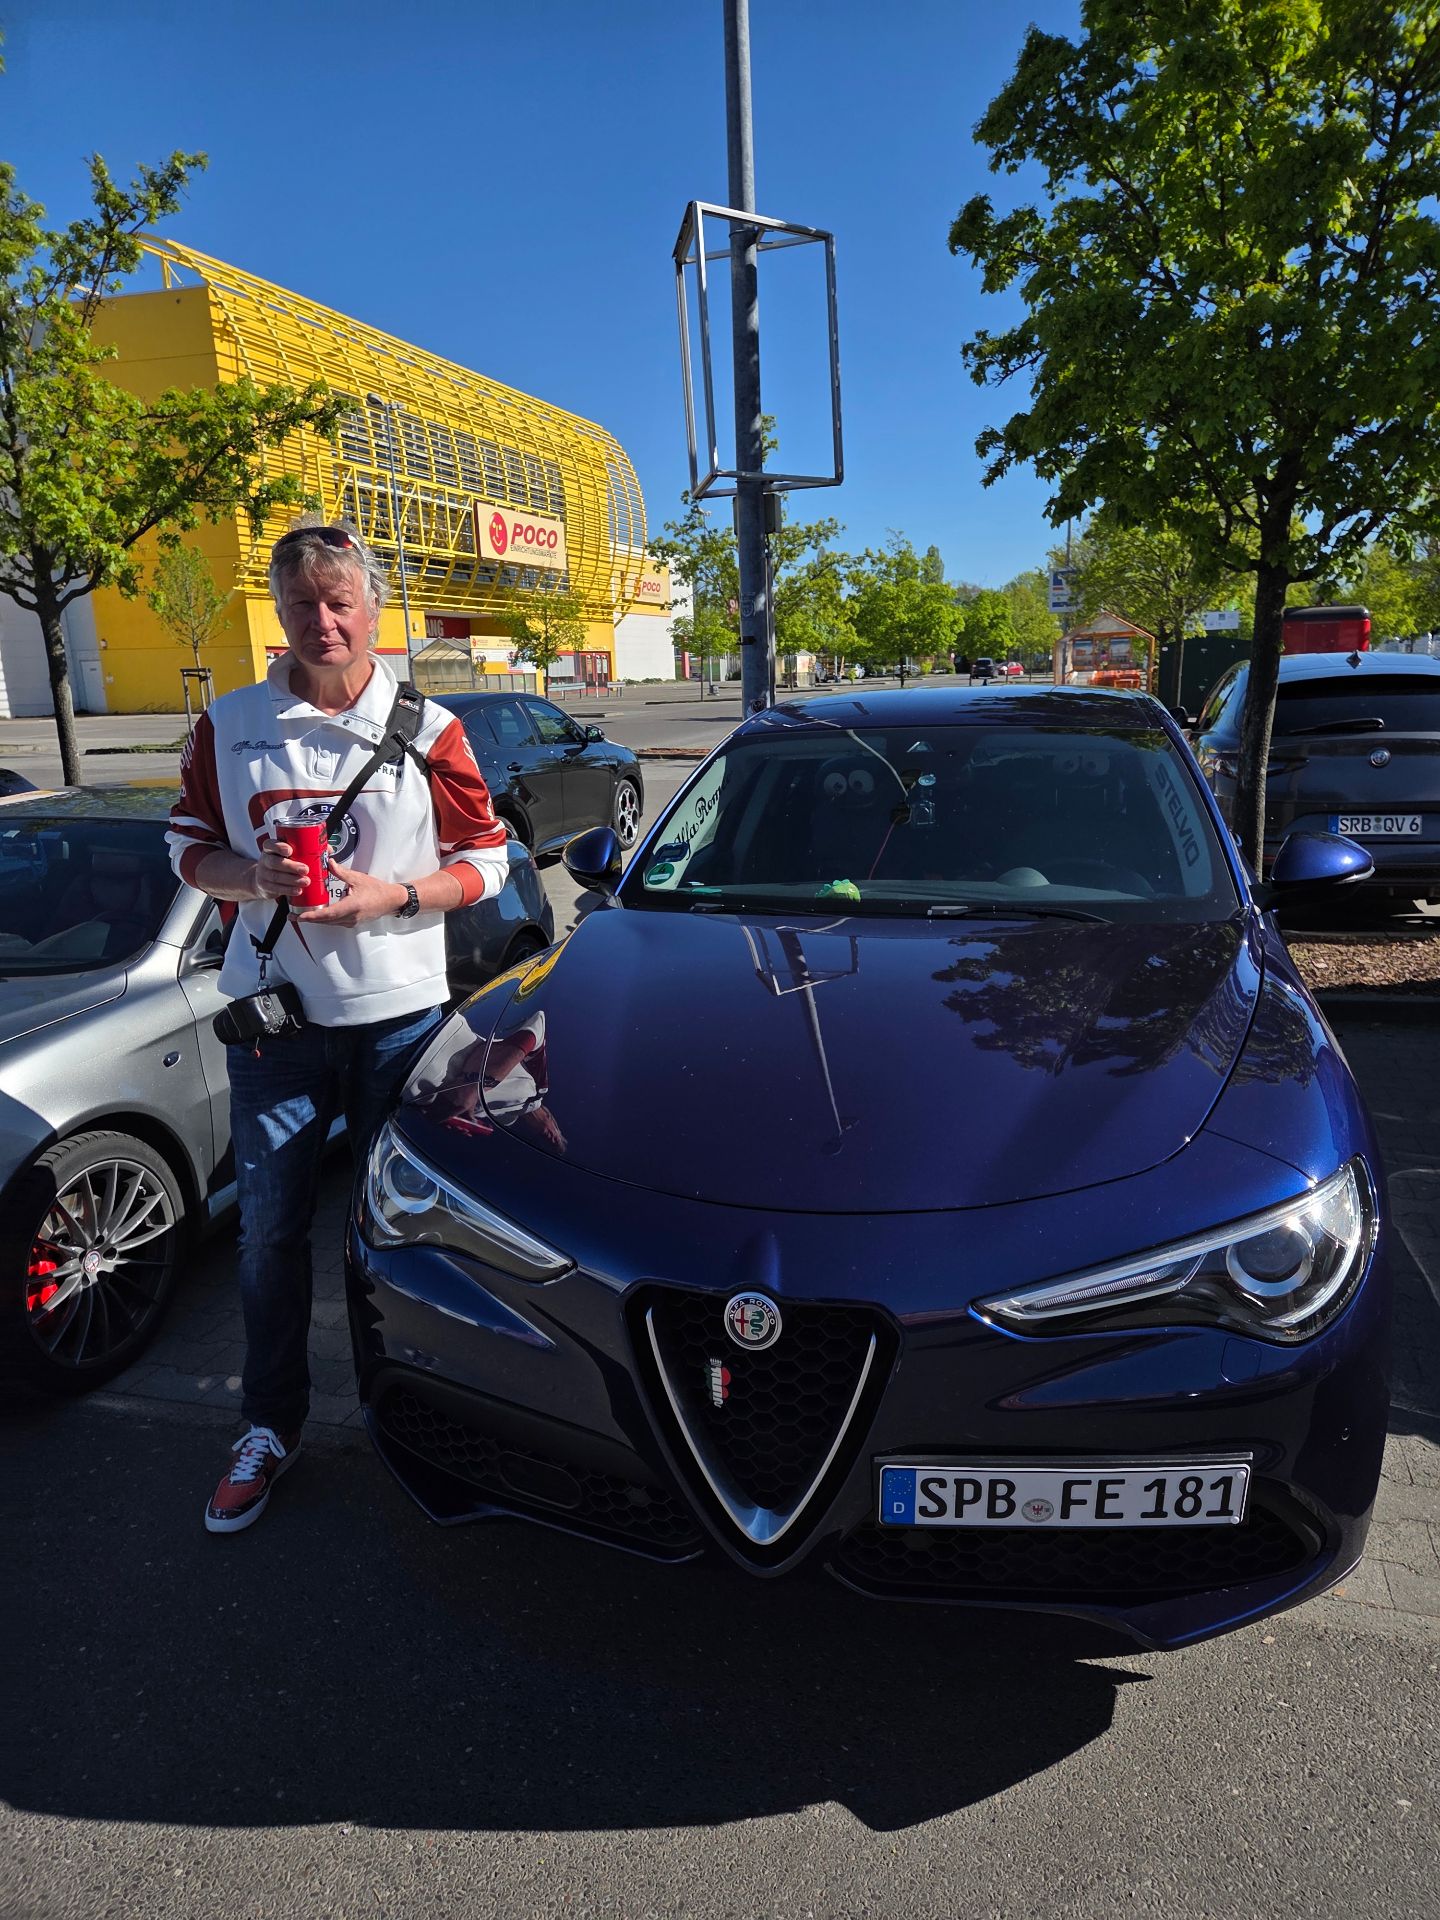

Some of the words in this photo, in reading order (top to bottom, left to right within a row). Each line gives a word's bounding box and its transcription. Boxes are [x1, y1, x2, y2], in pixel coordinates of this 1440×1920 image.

[511, 523, 557, 549] POCO
[642, 581, 661, 592] POCO
[1155, 762, 1200, 867] STELVIO
[1339, 817, 1372, 833] SRB
[1383, 817, 1406, 833] QV
[1409, 817, 1420, 833] 6
[730, 1301, 745, 1320] ALFA
[749, 1299, 775, 1325] ROMEO
[893, 1502, 905, 1514] D
[918, 1477, 1017, 1519] SPB
[1060, 1478, 1126, 1520] FE
[1140, 1475, 1234, 1519] 181
